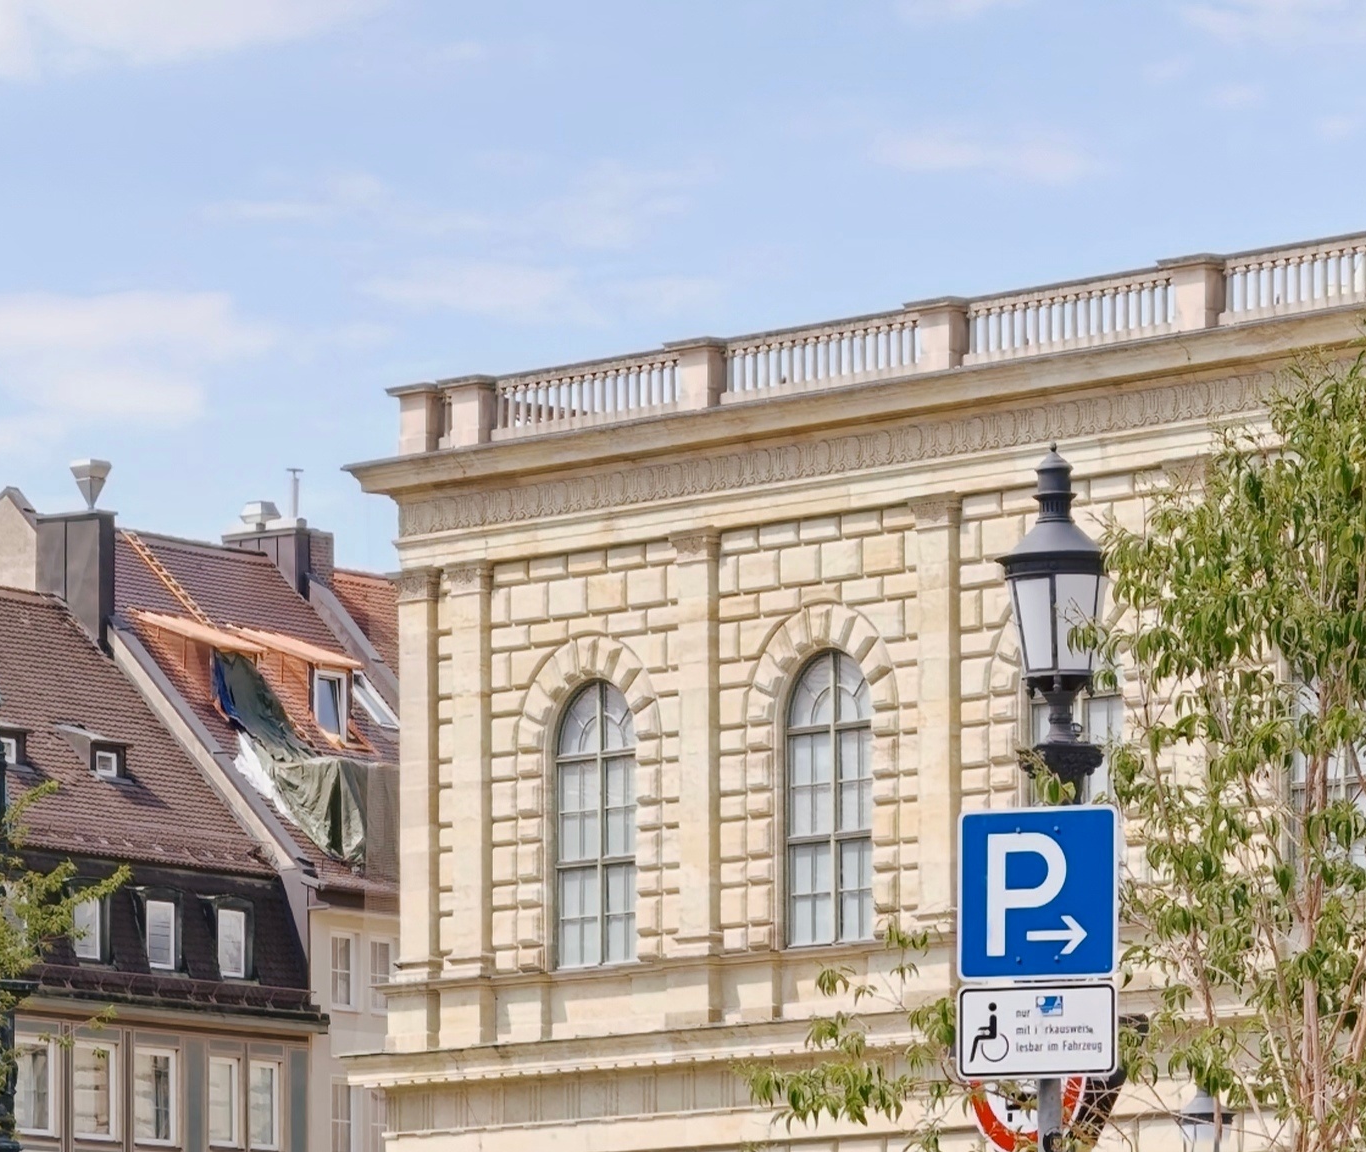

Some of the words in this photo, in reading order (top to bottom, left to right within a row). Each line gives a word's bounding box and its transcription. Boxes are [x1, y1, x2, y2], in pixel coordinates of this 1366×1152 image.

[986, 832, 1067, 957] P
[1015, 1009, 1031, 1018] nur
[1015, 1024, 1030, 1035] mit
[1015, 1041, 1043, 1053] lesbar
[1047, 1041, 1059, 1052] im
[1063, 1040, 1102, 1054] Fahrzeug
